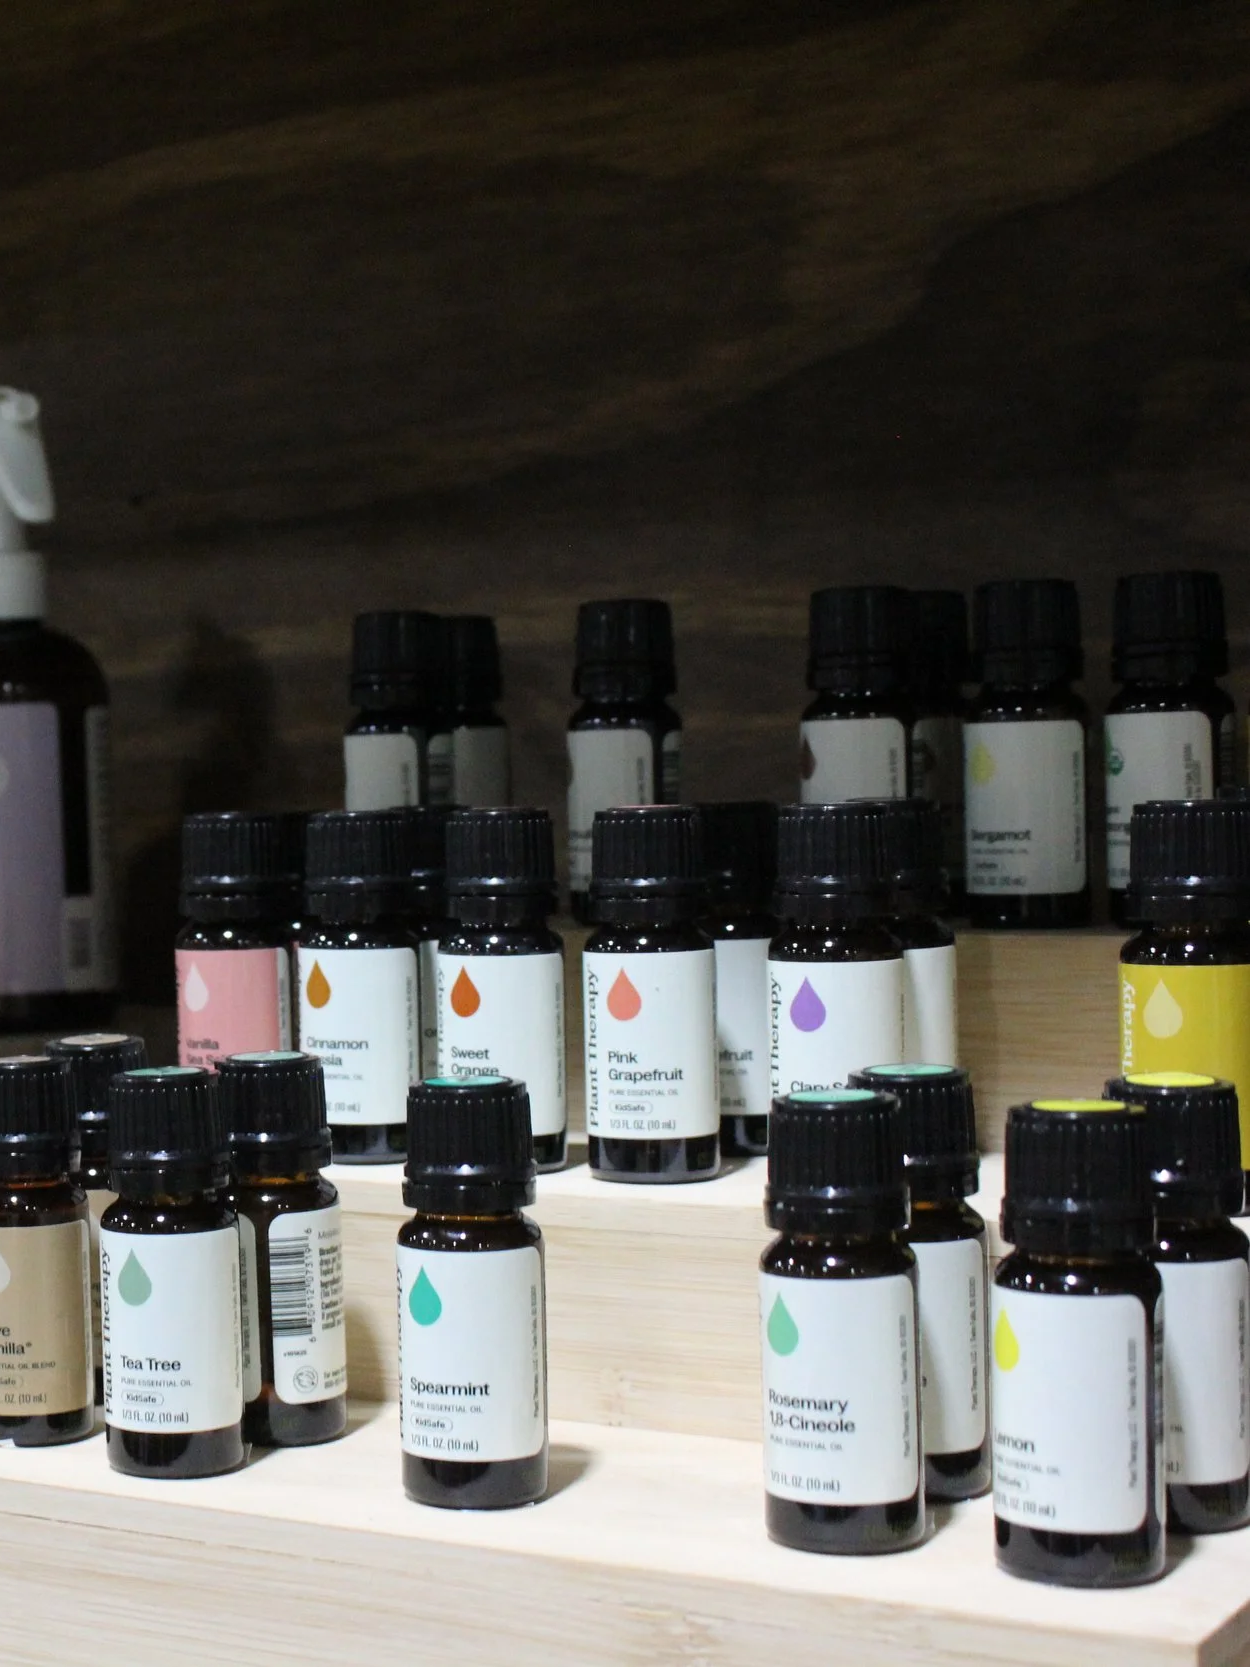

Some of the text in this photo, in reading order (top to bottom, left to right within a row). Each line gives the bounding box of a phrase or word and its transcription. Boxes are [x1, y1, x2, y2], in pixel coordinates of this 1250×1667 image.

[770, 979, 782, 1071] Therapy
[306, 1036, 369, 1050] Cinnamon
[589, 969, 599, 1128] Plant Therapy
[451, 1046, 490, 1060] Sweet
[607, 1050, 638, 1064] Pink
[451, 1063, 499, 1076] Orange
[608, 1068, 684, 1083] Grapefruit
[615, 1103, 645, 1112] KidSafe
[609, 1119, 622, 1129] 1/3
[647, 1119, 661, 1130] (10
[661, 1120, 676, 1131] mL)
[102, 1247, 113, 1415] Plant Therapy
[31, 1361, 56, 1369] BLEND
[120, 1355, 181, 1371] Tea Tree
[410, 1376, 490, 1396] Spearmint
[18, 1393, 31, 1404] (10
[32, 1393, 47, 1404] mL)
[126, 1394, 157, 1403] KidSafe
[769, 1388, 848, 1415] Rosemary
[427, 1402, 467, 1412] ESSENTIAL
[122, 1409, 132, 1421] 1/3
[158, 1411, 172, 1424] (10
[173, 1412, 189, 1424] mL)
[415, 1417, 446, 1429] KidSafe
[411, 1434, 421, 1446] 1/3
[447, 1437, 461, 1450] (10
[462, 1438, 479, 1452] mL)
[806, 1476, 821, 1491] (10
[822, 1478, 841, 1493] mL)
